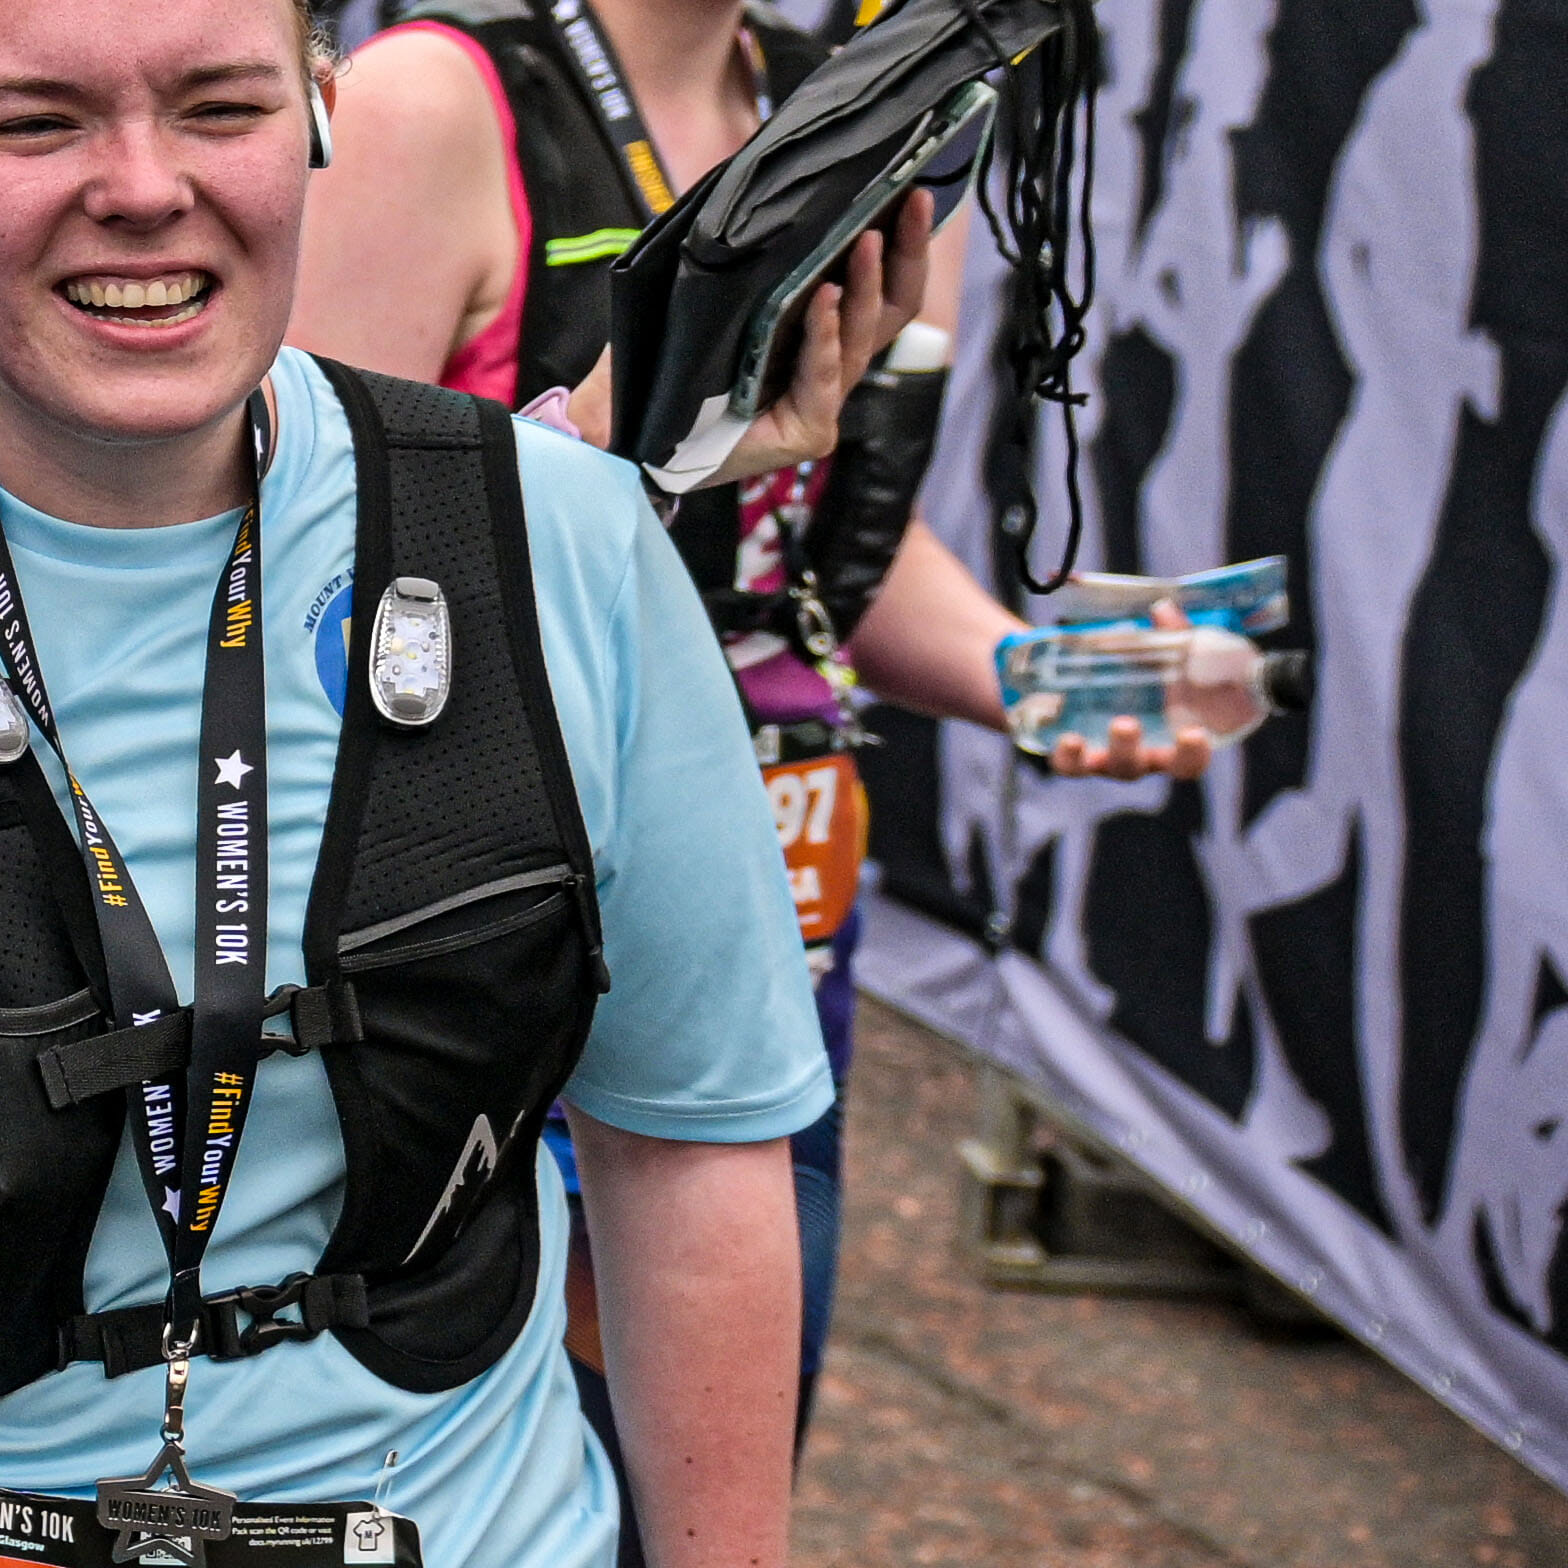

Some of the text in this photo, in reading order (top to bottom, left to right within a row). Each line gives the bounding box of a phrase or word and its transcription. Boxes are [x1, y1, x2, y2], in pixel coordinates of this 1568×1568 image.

[304, 574, 342, 634] MOUNT
[5, 619, 50, 728] WOMEN'S
[215, 800, 248, 966] WOMEN'S 10K
[142, 1080, 177, 1176] WOMEN'
[190, 1071, 245, 1231] #FindYourWhy
[40, 1510, 75, 1544] 10K
[107, 1498, 222, 1532] WOMEN'S 10K
[277, 1526, 290, 1535] QR
